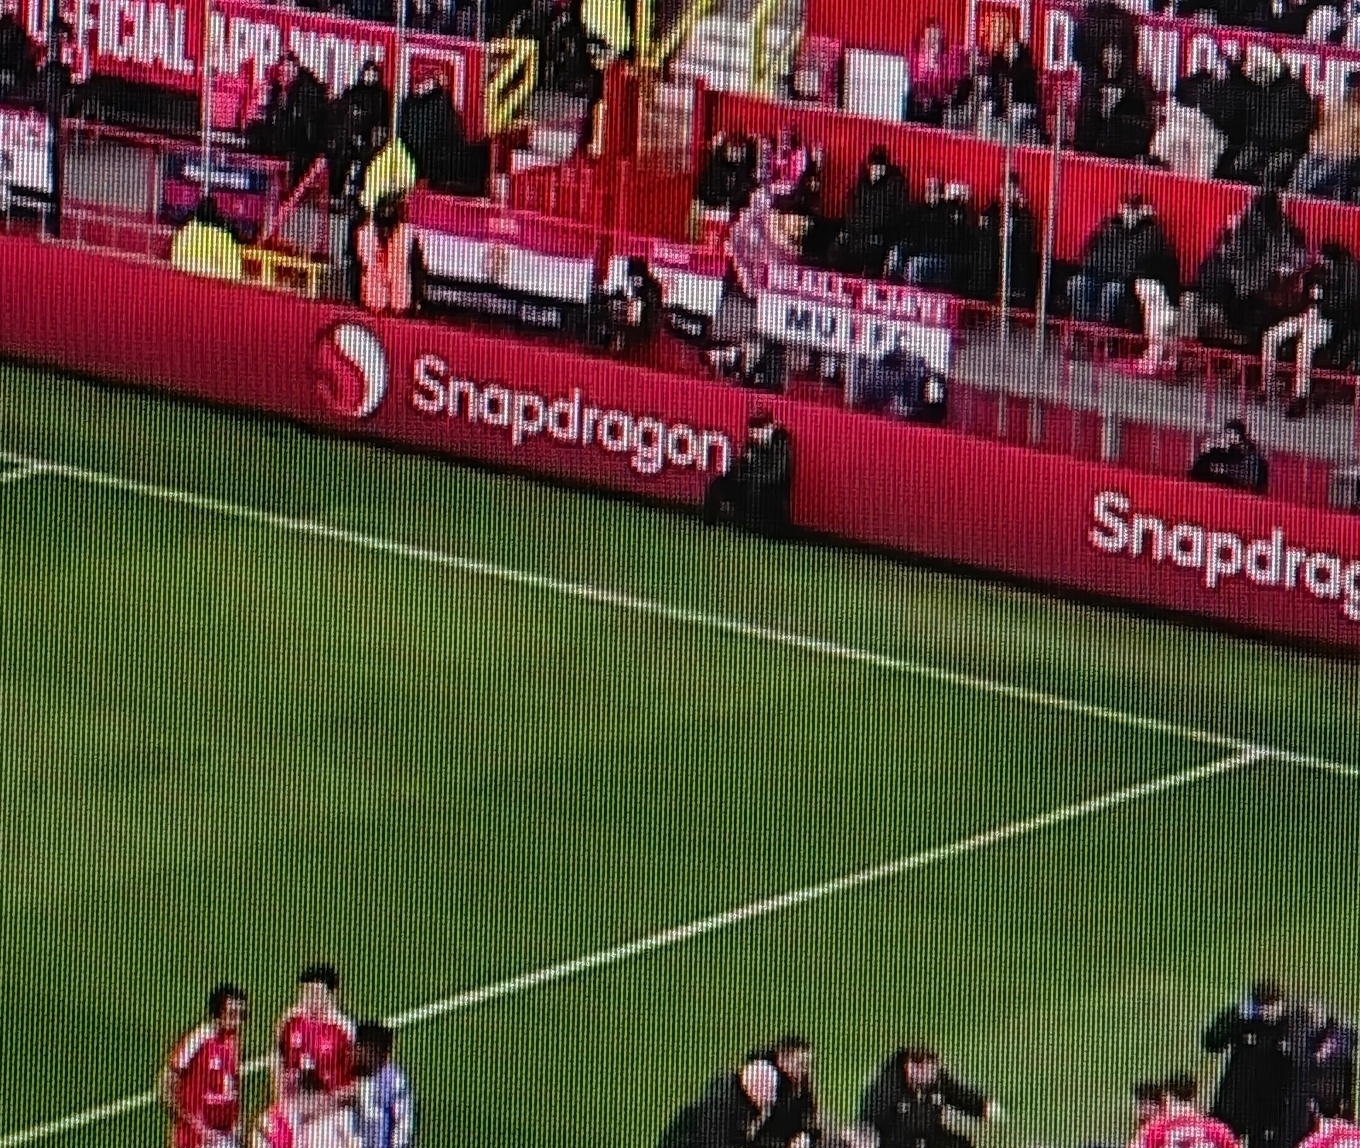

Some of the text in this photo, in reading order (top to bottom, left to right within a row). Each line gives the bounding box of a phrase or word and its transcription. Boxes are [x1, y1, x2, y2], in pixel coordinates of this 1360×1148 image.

[26, 0, 195, 80] OFICIAL
[206, 10, 280, 85] APP
[411, 354, 732, 474] Snapdragon
